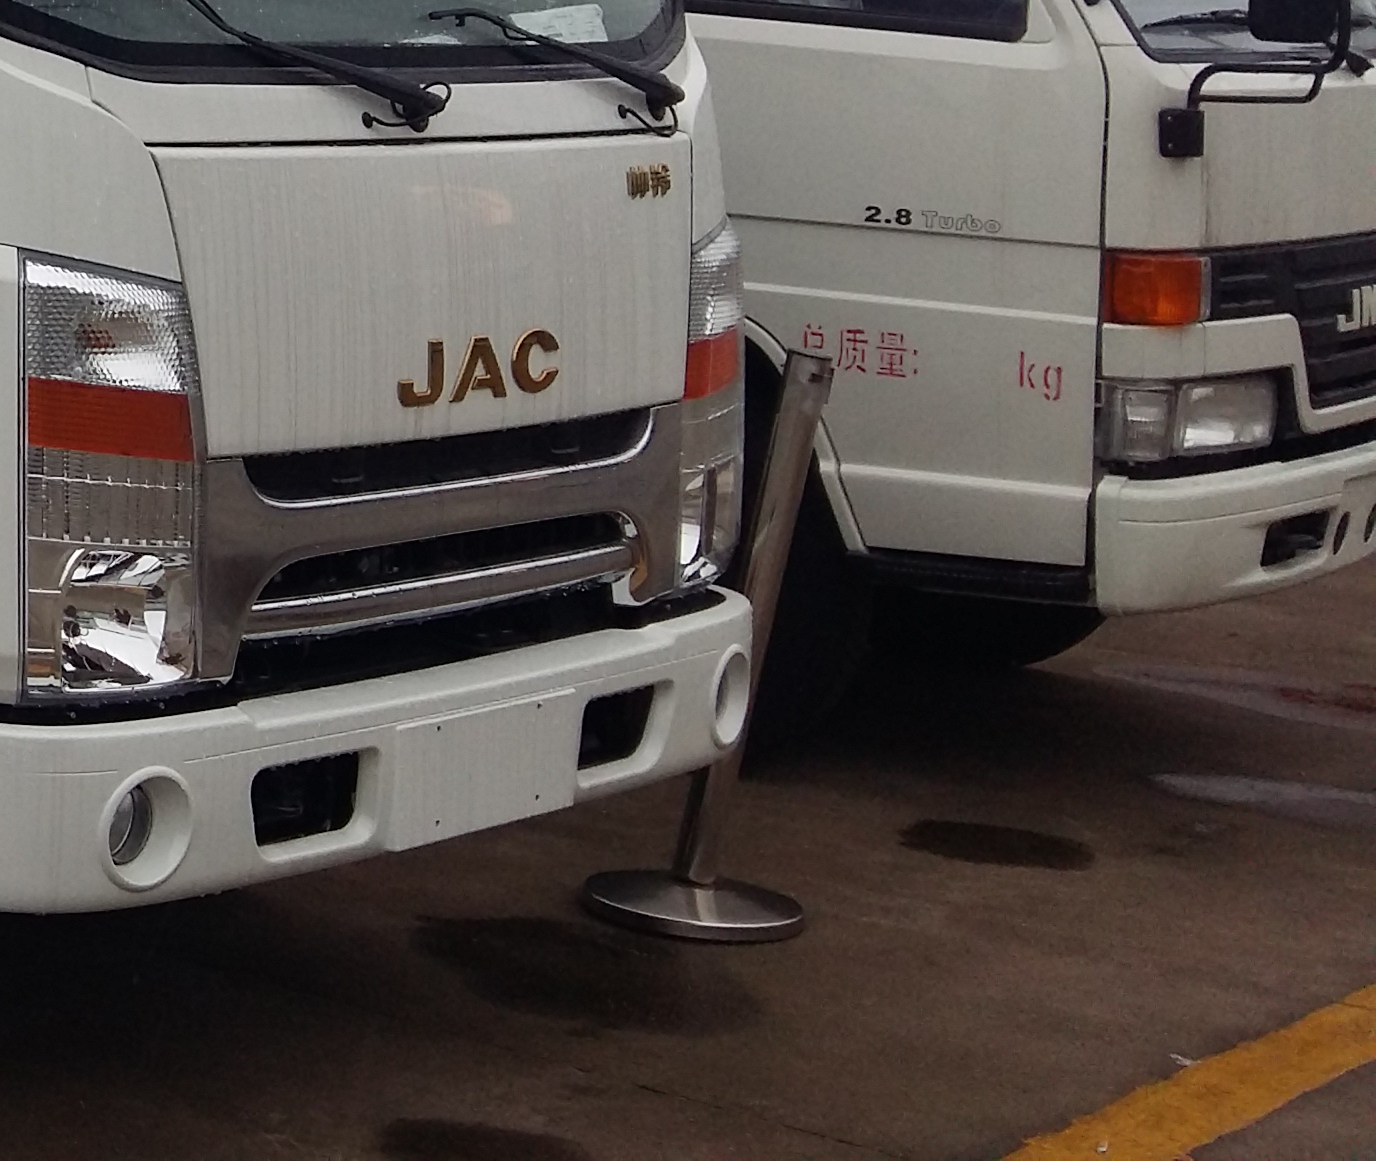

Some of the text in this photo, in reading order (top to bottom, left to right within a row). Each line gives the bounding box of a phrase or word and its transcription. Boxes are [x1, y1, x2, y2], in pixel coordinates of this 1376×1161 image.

[864, 206, 1001, 234] 2.8 Turbo
[397, 329, 560, 407] JAC
[1018, 350, 1063, 401] kg
